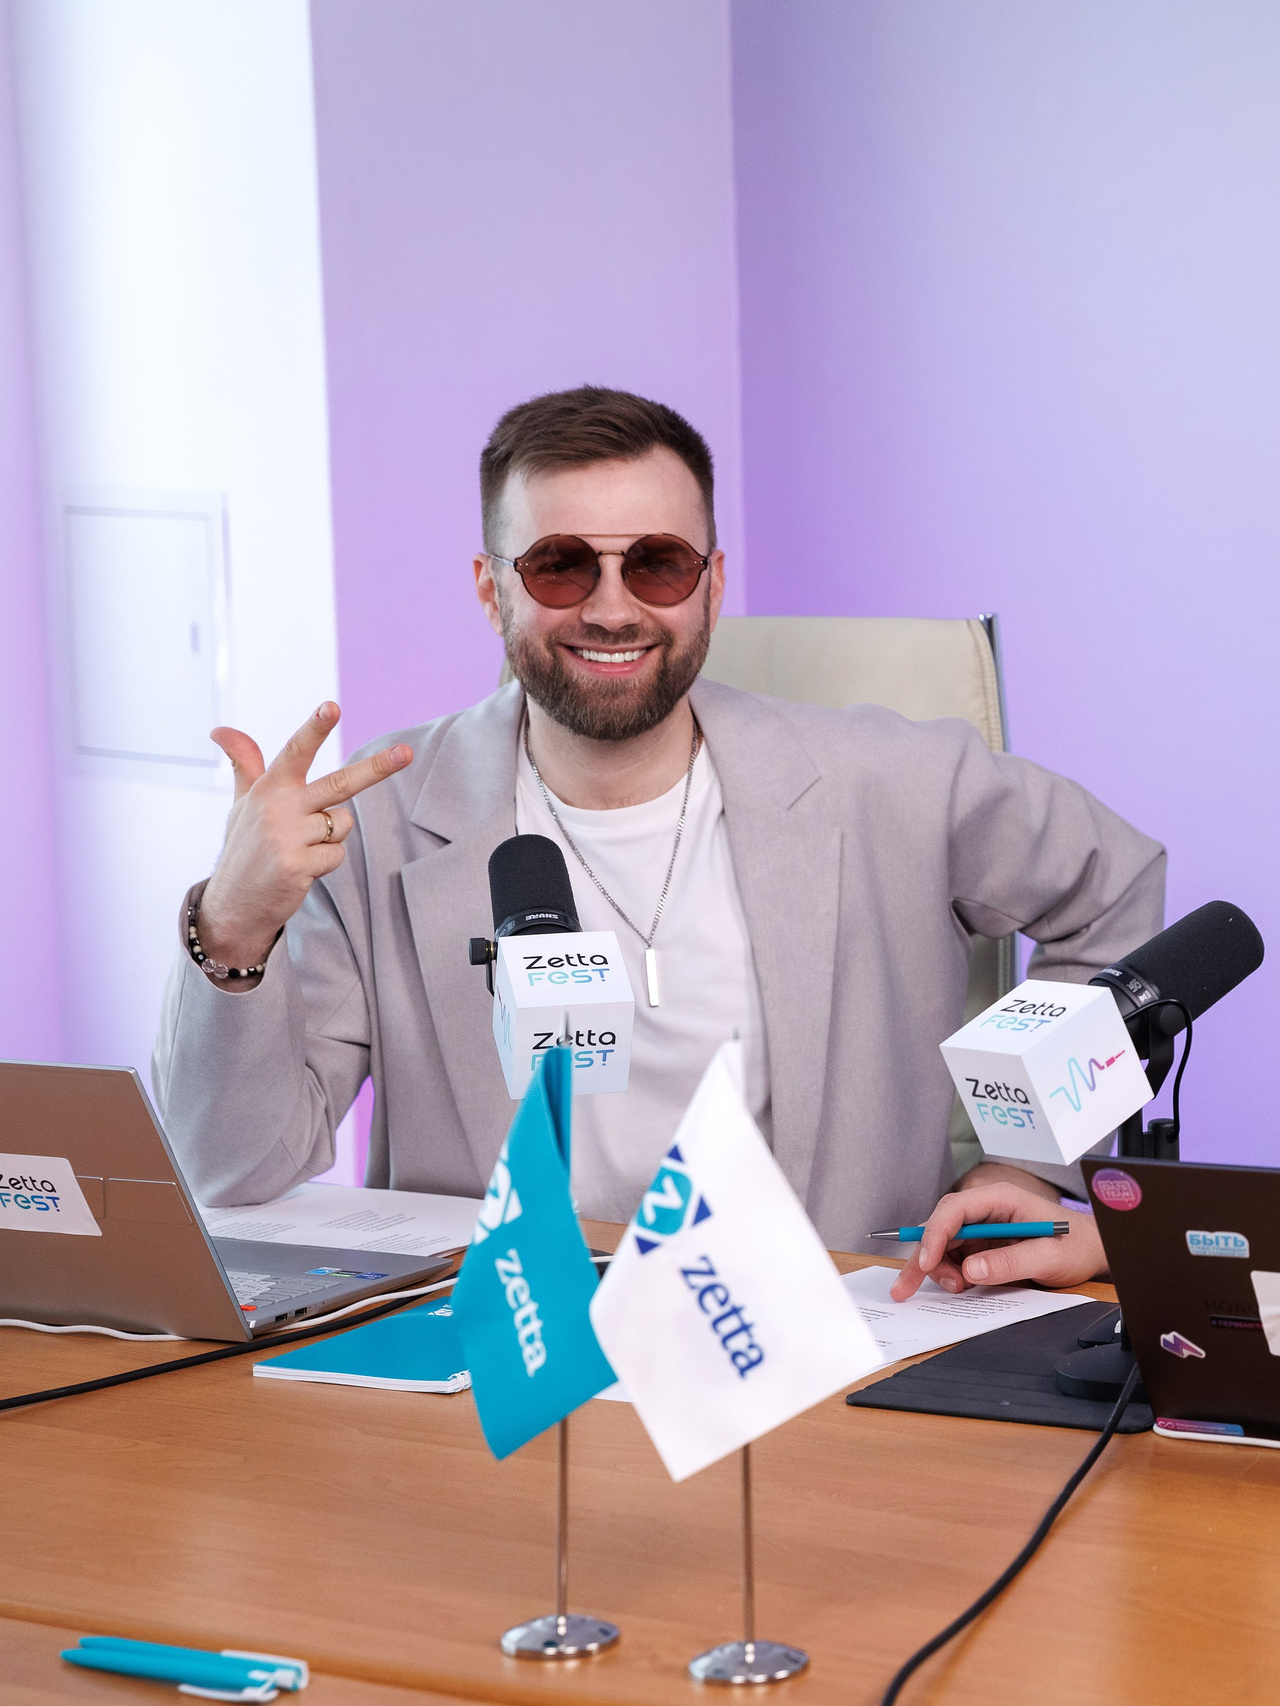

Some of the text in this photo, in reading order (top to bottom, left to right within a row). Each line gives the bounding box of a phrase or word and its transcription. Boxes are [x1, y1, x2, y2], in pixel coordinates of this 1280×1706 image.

[523, 953, 609, 970] Zetta
[1000, 999, 1067, 1018] Zetta
[531, 1049, 615, 1071] FST
[965, 1077, 1031, 1105] Zetta
[1189, 1233, 1245, 1247] БЫТЬ
[495, 1247, 547, 1378] zetta
[680, 1255, 765, 1379] zetta
